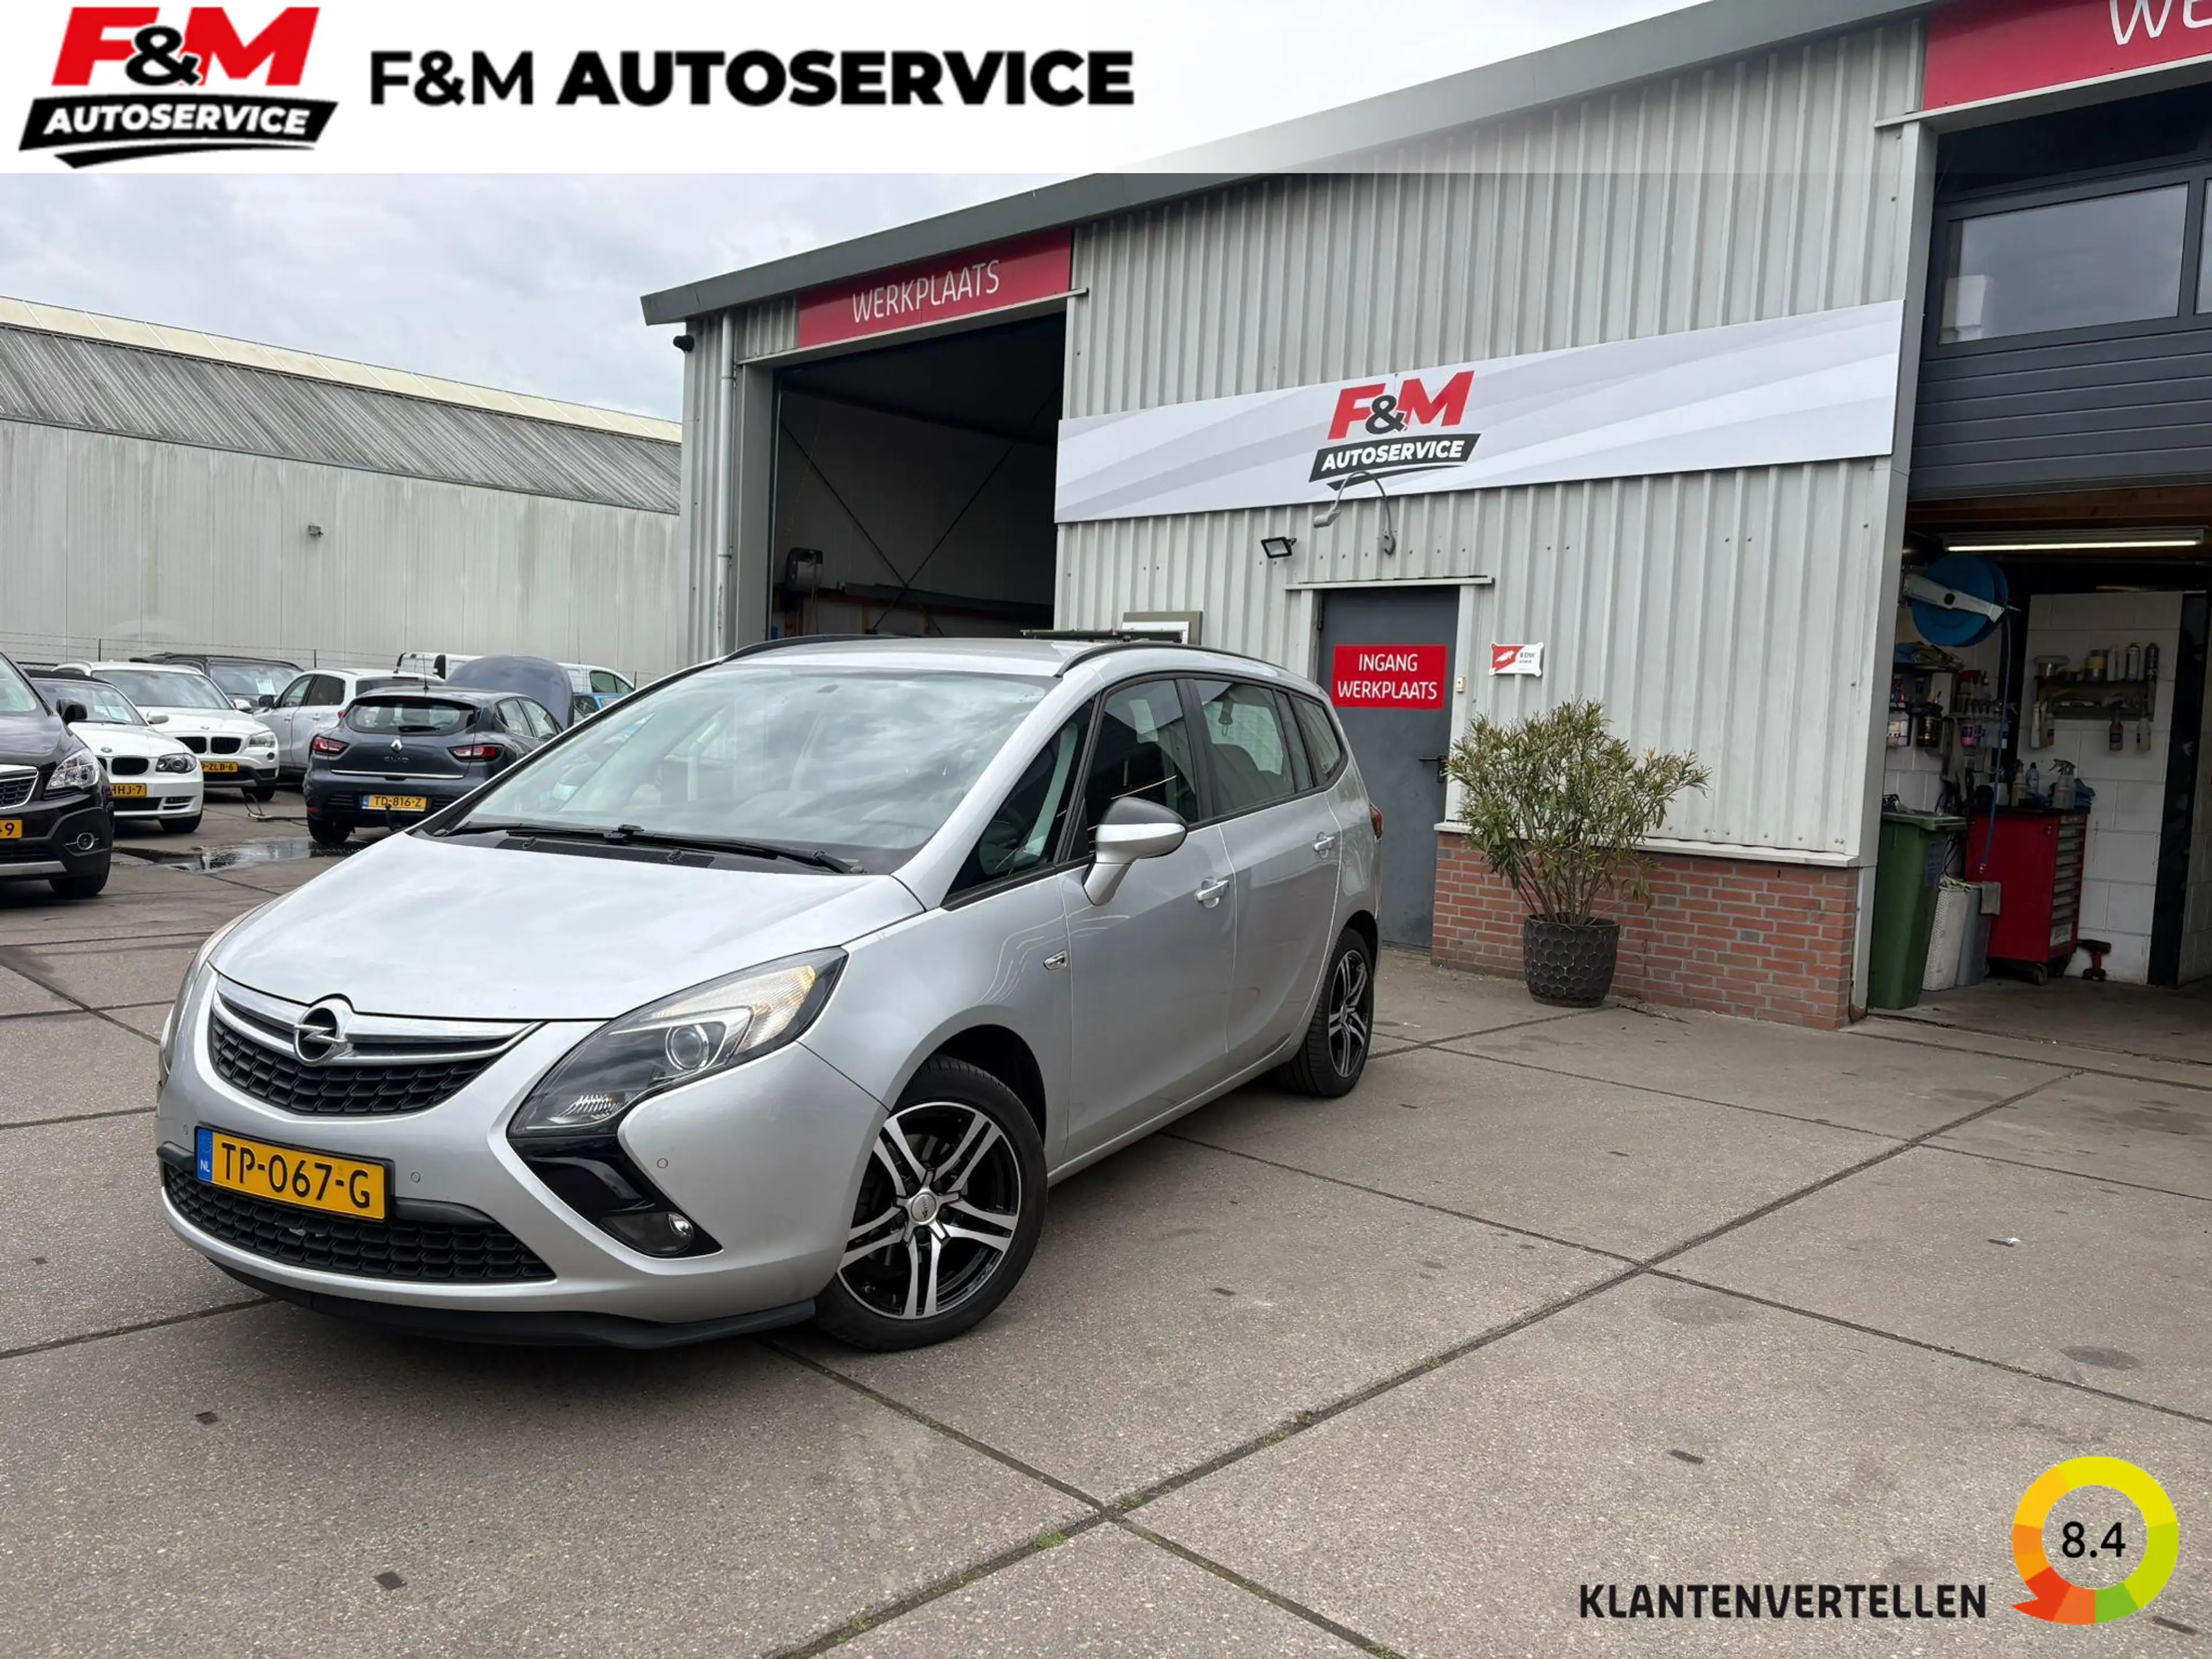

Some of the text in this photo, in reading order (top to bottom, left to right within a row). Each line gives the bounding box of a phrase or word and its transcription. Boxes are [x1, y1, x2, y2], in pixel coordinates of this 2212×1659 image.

[853, 259, 999, 323] WERKPLAATS
[1327, 370, 1475, 440] F&M
[1320, 440, 1465, 472] AUTOSERVICE
[1358, 653, 1418, 672] INGANG
[1337, 680, 1438, 700] WERKPLAATS
[374, 796, 422, 807] TD-816-Z
[221, 1142, 370, 1209] TP-067-G
